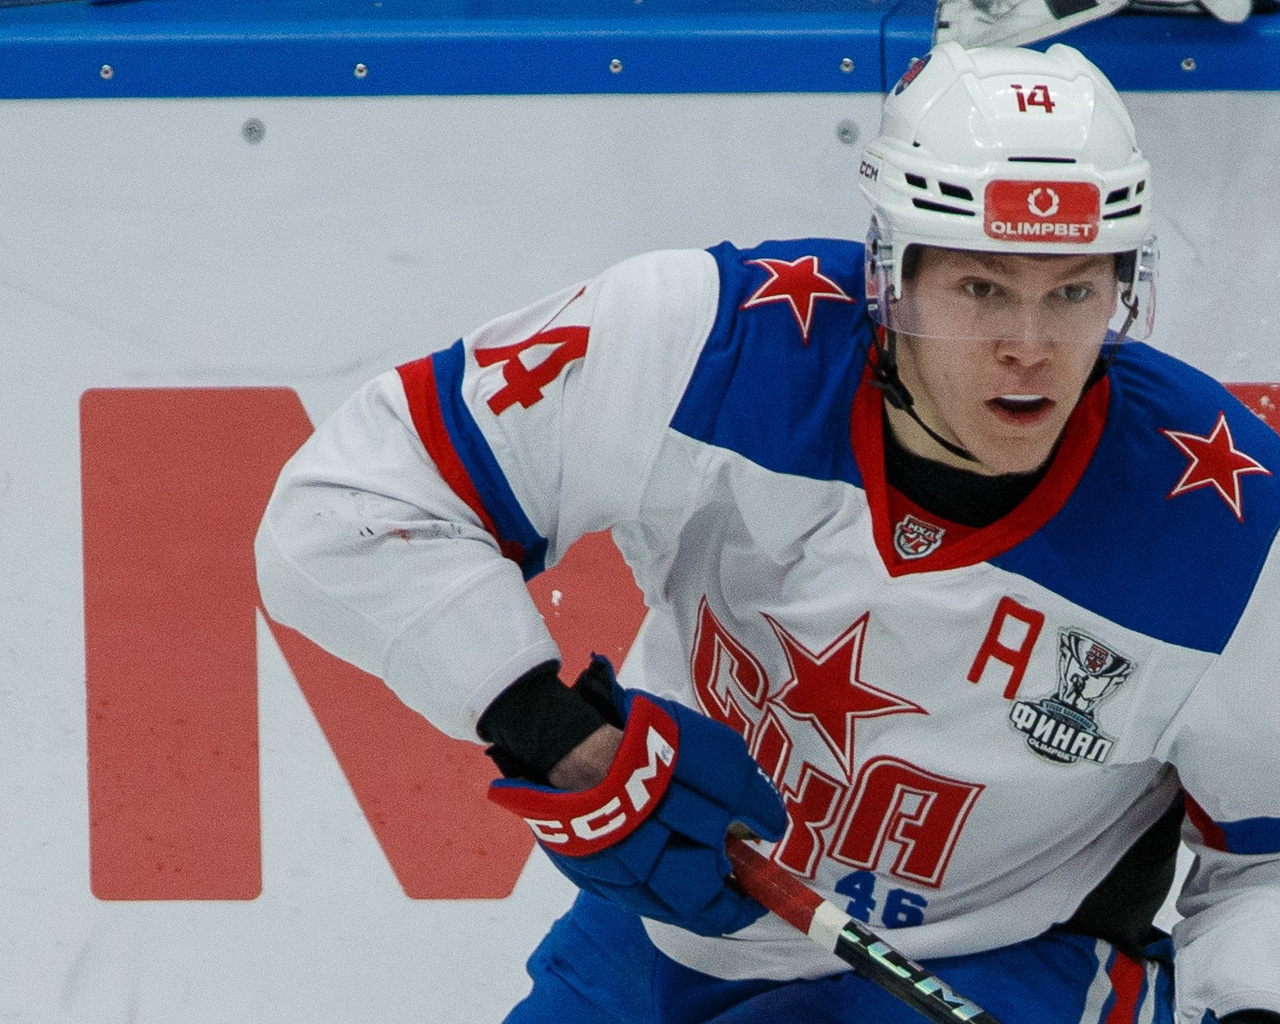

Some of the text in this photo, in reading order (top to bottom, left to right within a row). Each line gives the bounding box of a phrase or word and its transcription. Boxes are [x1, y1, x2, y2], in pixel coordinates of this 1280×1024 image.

[1010, 84, 1055, 113] 14
[859, 160, 879, 182] CCM
[990, 220, 1092, 237] OLIMPBET
[1010, 700, 1114, 763] ФИНАЛ
[523, 725, 675, 843] CCM
[834, 870, 929, 929] 46
